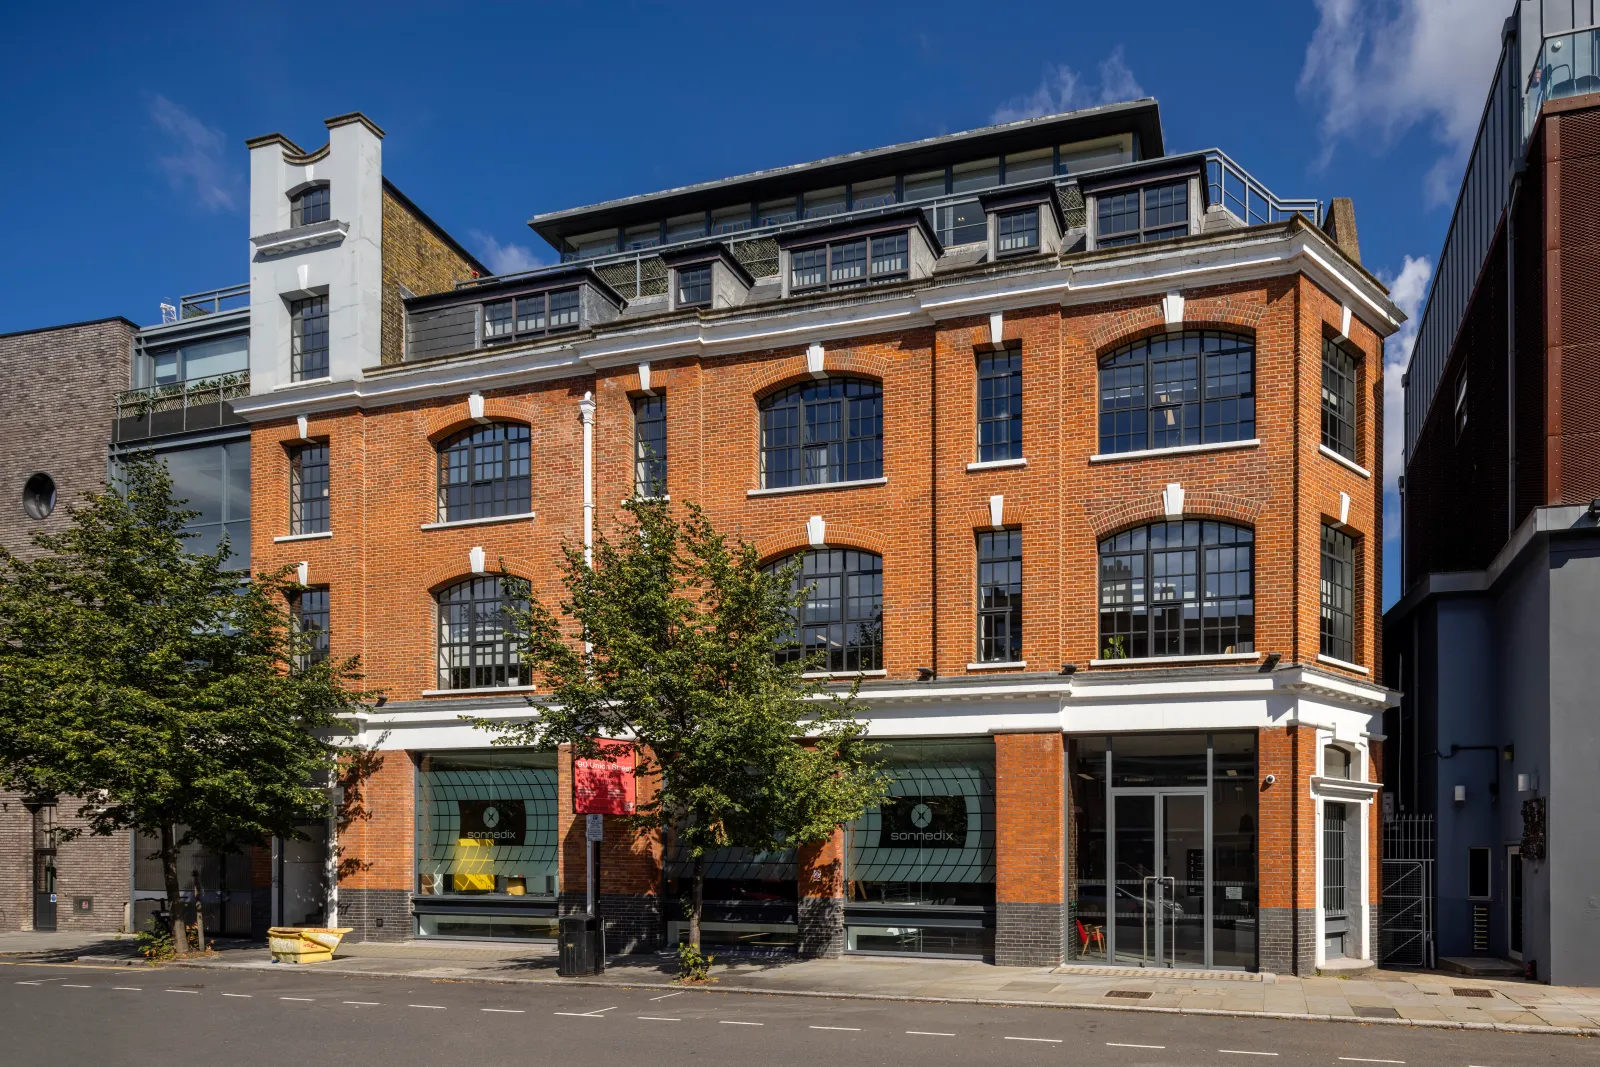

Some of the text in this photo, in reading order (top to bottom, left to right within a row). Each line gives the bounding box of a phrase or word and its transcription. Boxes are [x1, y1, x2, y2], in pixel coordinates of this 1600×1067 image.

[590, 761, 610, 770] Union
[612, 764, 632, 772] Street
[468, 830, 516, 839] sonnedix
[891, 830, 953, 840] sonnedix
